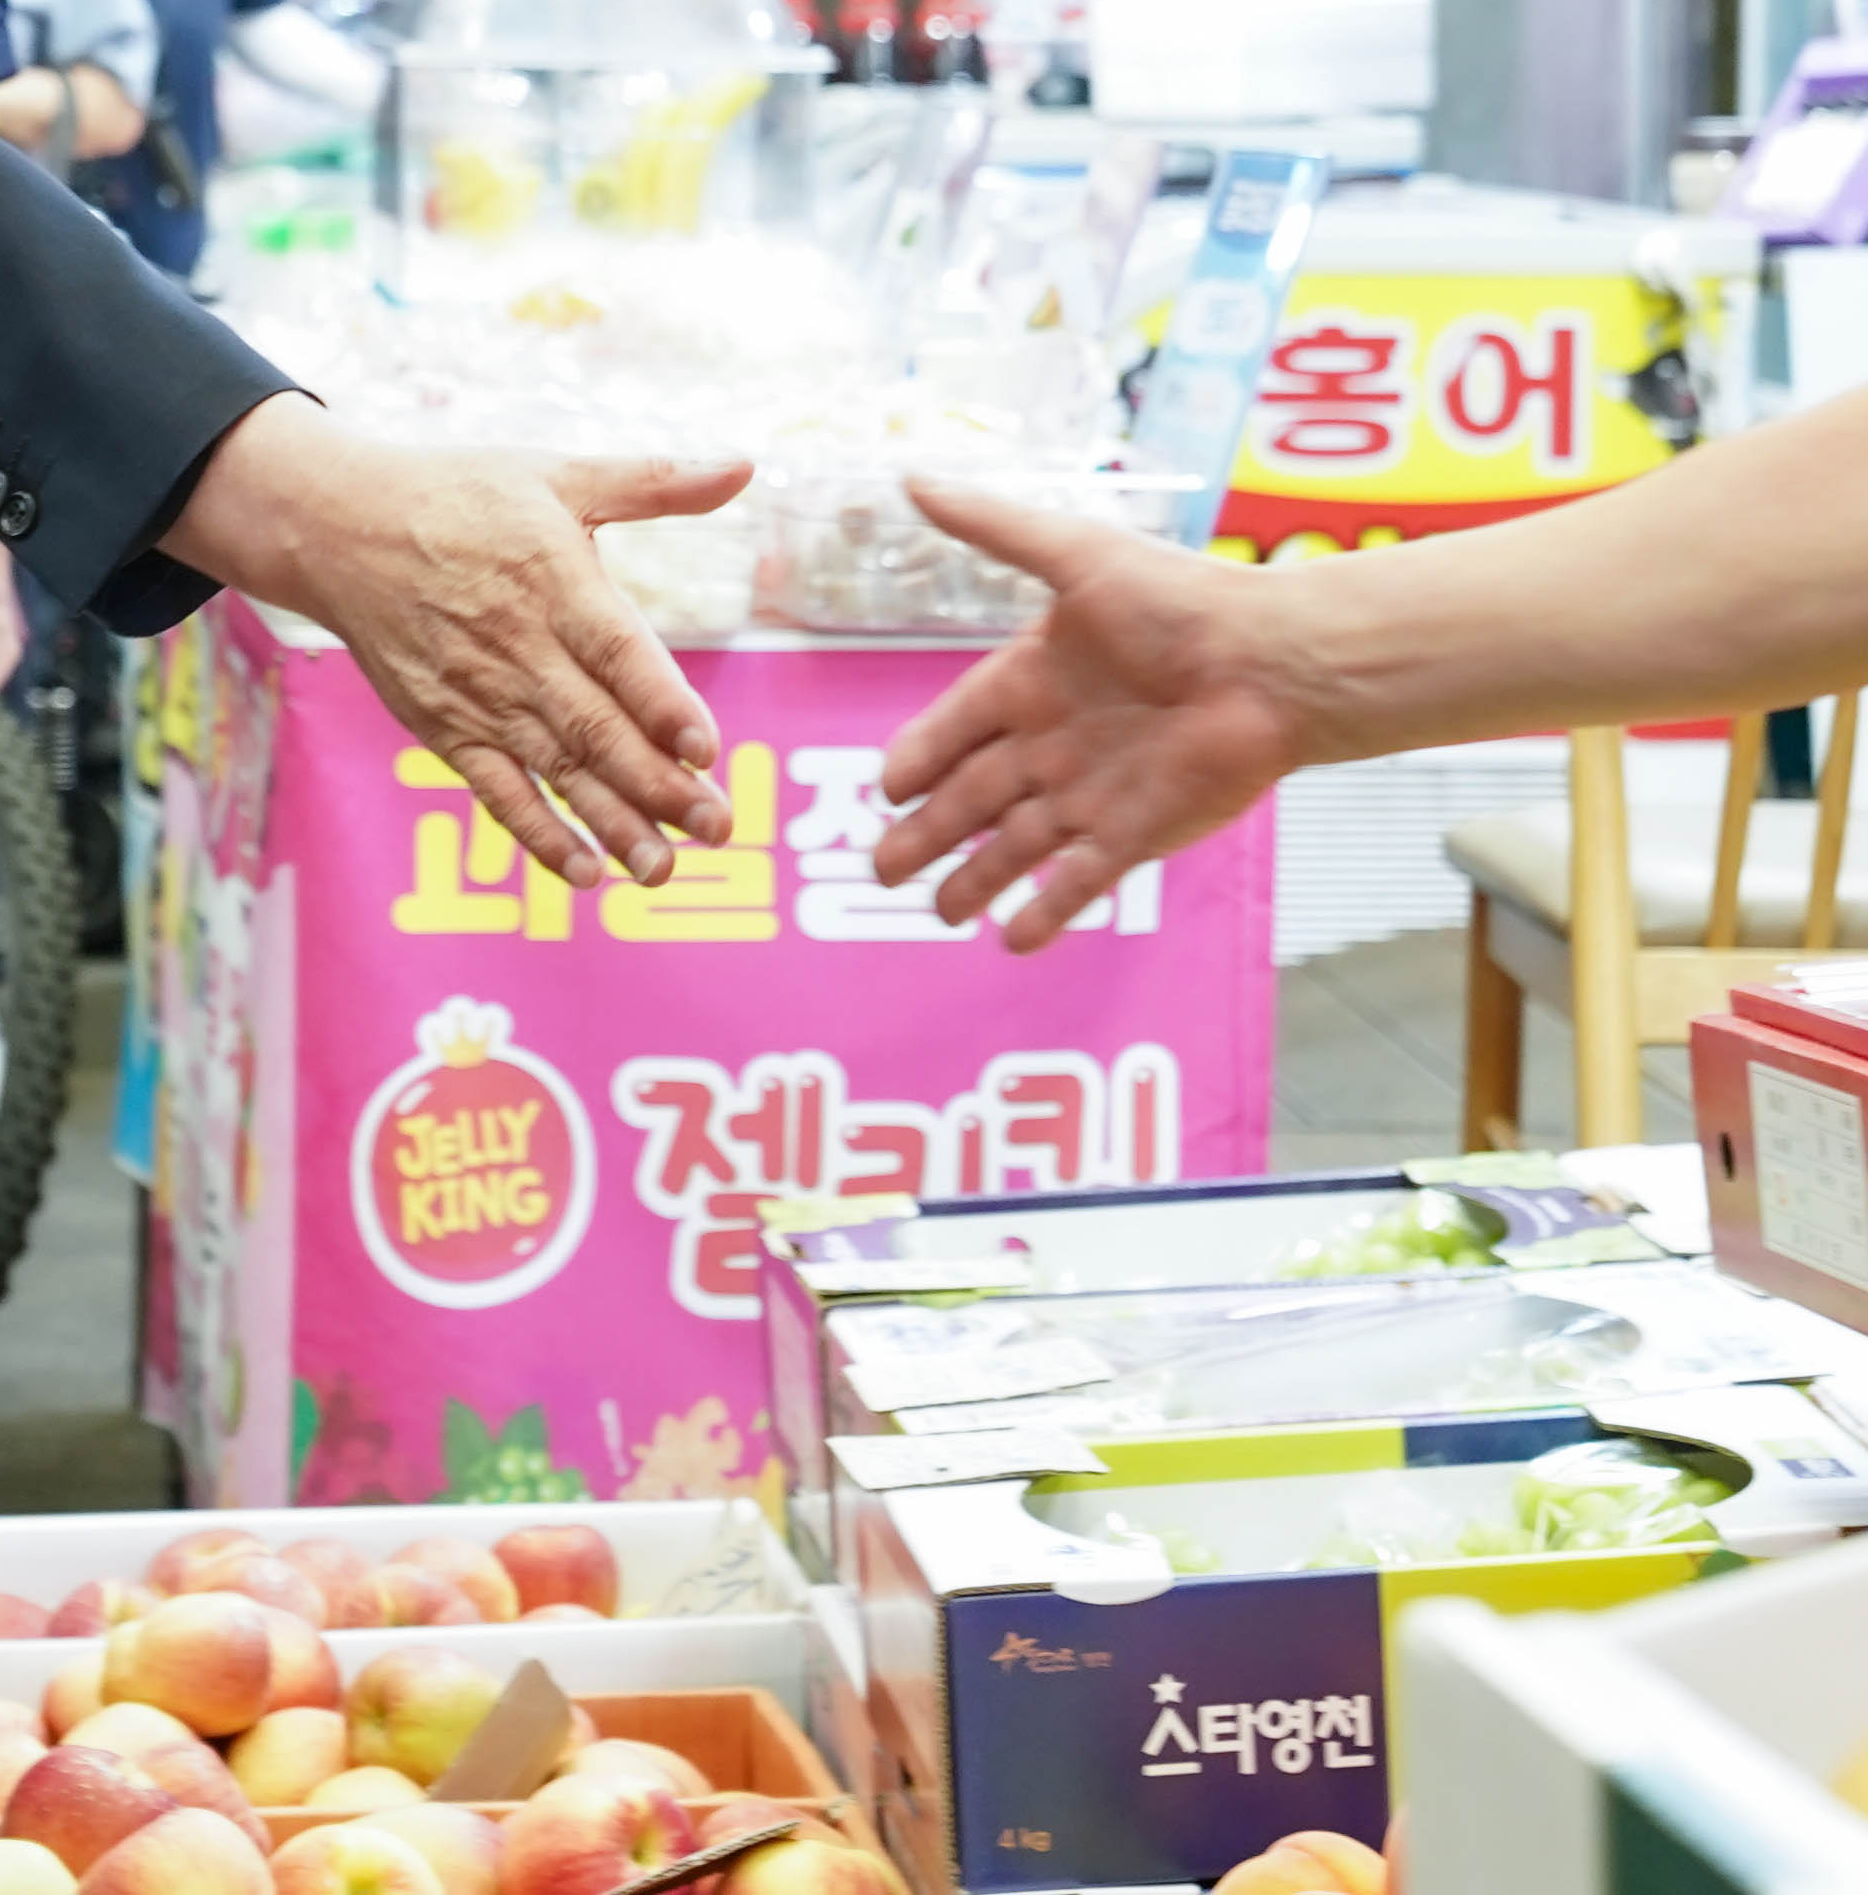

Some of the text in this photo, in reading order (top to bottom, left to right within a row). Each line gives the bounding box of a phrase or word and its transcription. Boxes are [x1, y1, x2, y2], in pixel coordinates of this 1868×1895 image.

[1257, 326, 1574, 459] 홍어
[401, 1165, 552, 1245] KING
[1140, 1694, 1376, 1778] 스타영천
